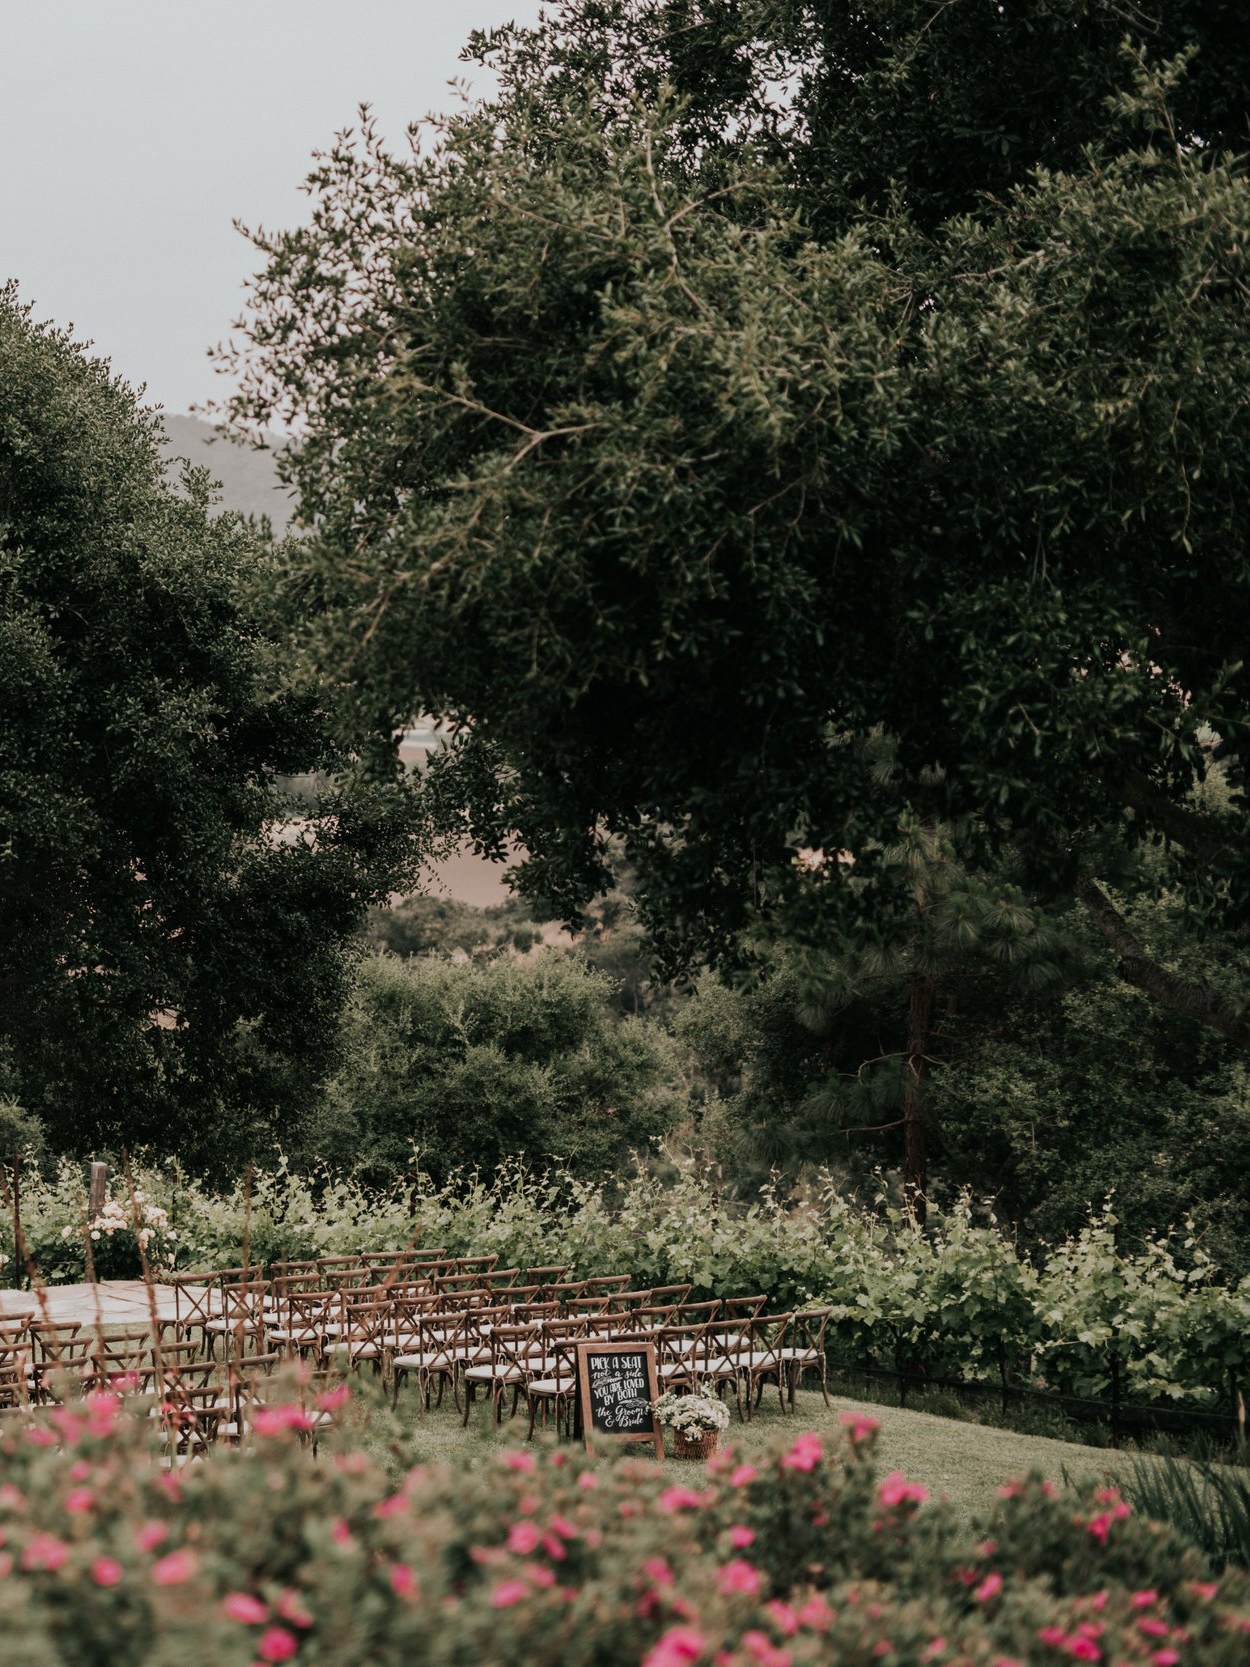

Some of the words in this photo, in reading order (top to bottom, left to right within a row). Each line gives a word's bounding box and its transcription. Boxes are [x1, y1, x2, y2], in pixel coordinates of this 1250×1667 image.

[591, 1357, 609, 1369] PICK
[612, 1357, 619, 1369] A
[621, 1356, 641, 1368] SEAT
[591, 1369, 611, 1379] not
[625, 1368, 643, 1378] side
[594, 1387, 608, 1399] YOU
[610, 1381, 622, 1393] ARE
[624, 1378, 644, 1389] LOVED
[604, 1394, 614, 1406] BY
[617, 1388, 637, 1400] BOTH
[596, 1407, 612, 1417] the
[605, 1416, 614, 1427] &
[619, 1414, 644, 1427] Bride
